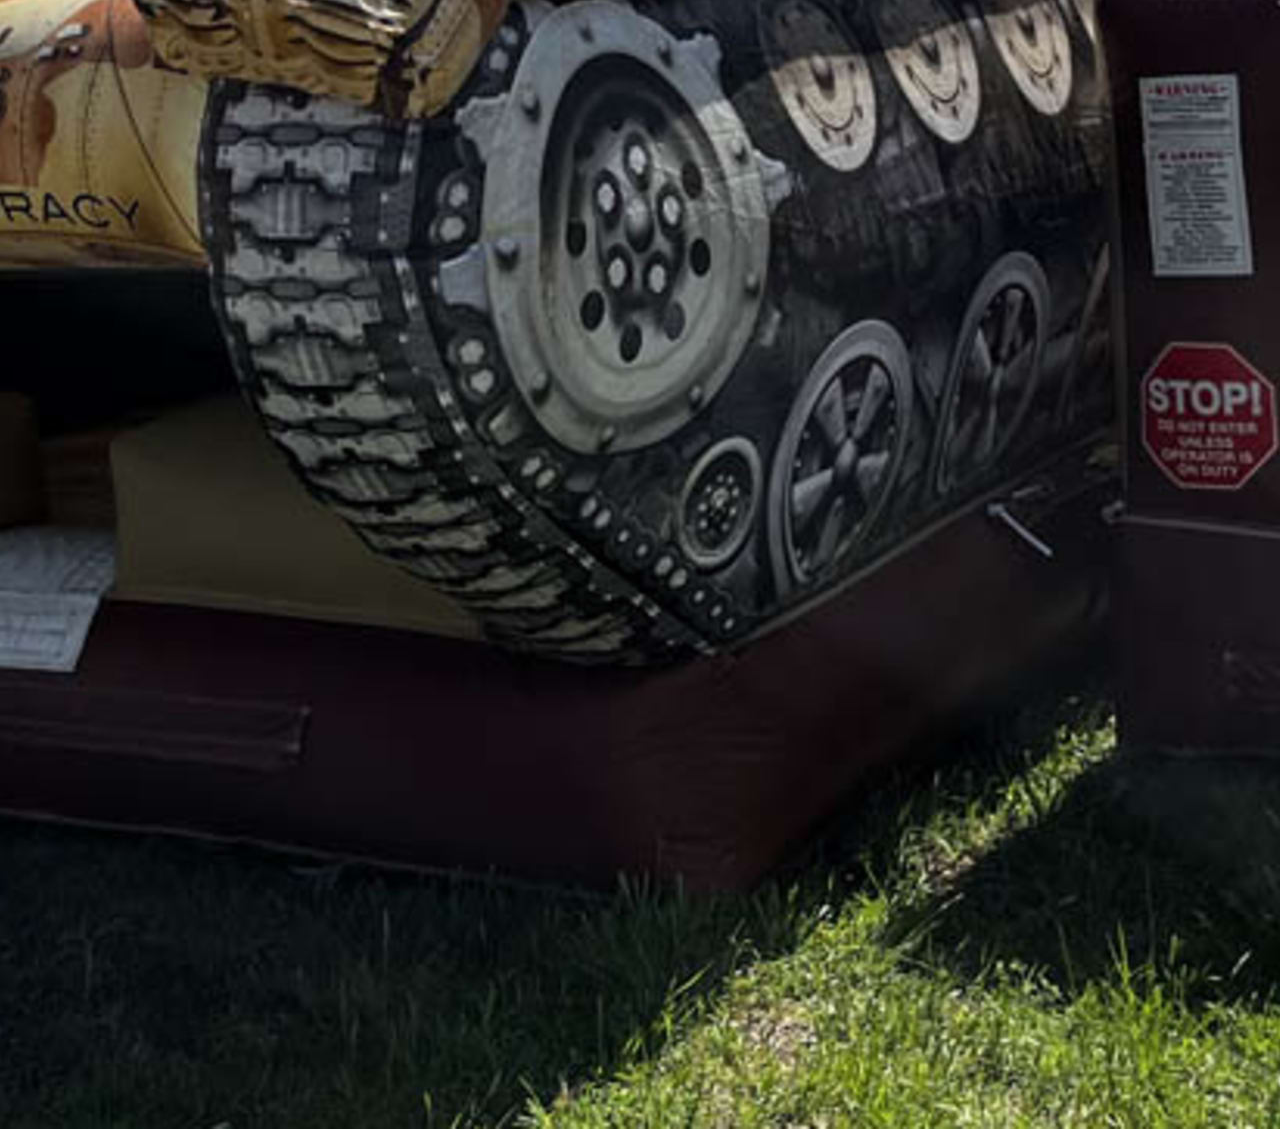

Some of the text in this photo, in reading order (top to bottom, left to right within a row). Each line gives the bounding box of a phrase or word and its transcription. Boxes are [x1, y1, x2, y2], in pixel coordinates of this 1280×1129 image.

[1147, 377, 1263, 417] STOP!
[1156, 418, 1259, 436] DO NOT ENTER
[1176, 435, 1235, 449] UNLESS
[1160, 447, 1237, 463] OPERATOR
[1201, 463, 1239, 478] DUTY
